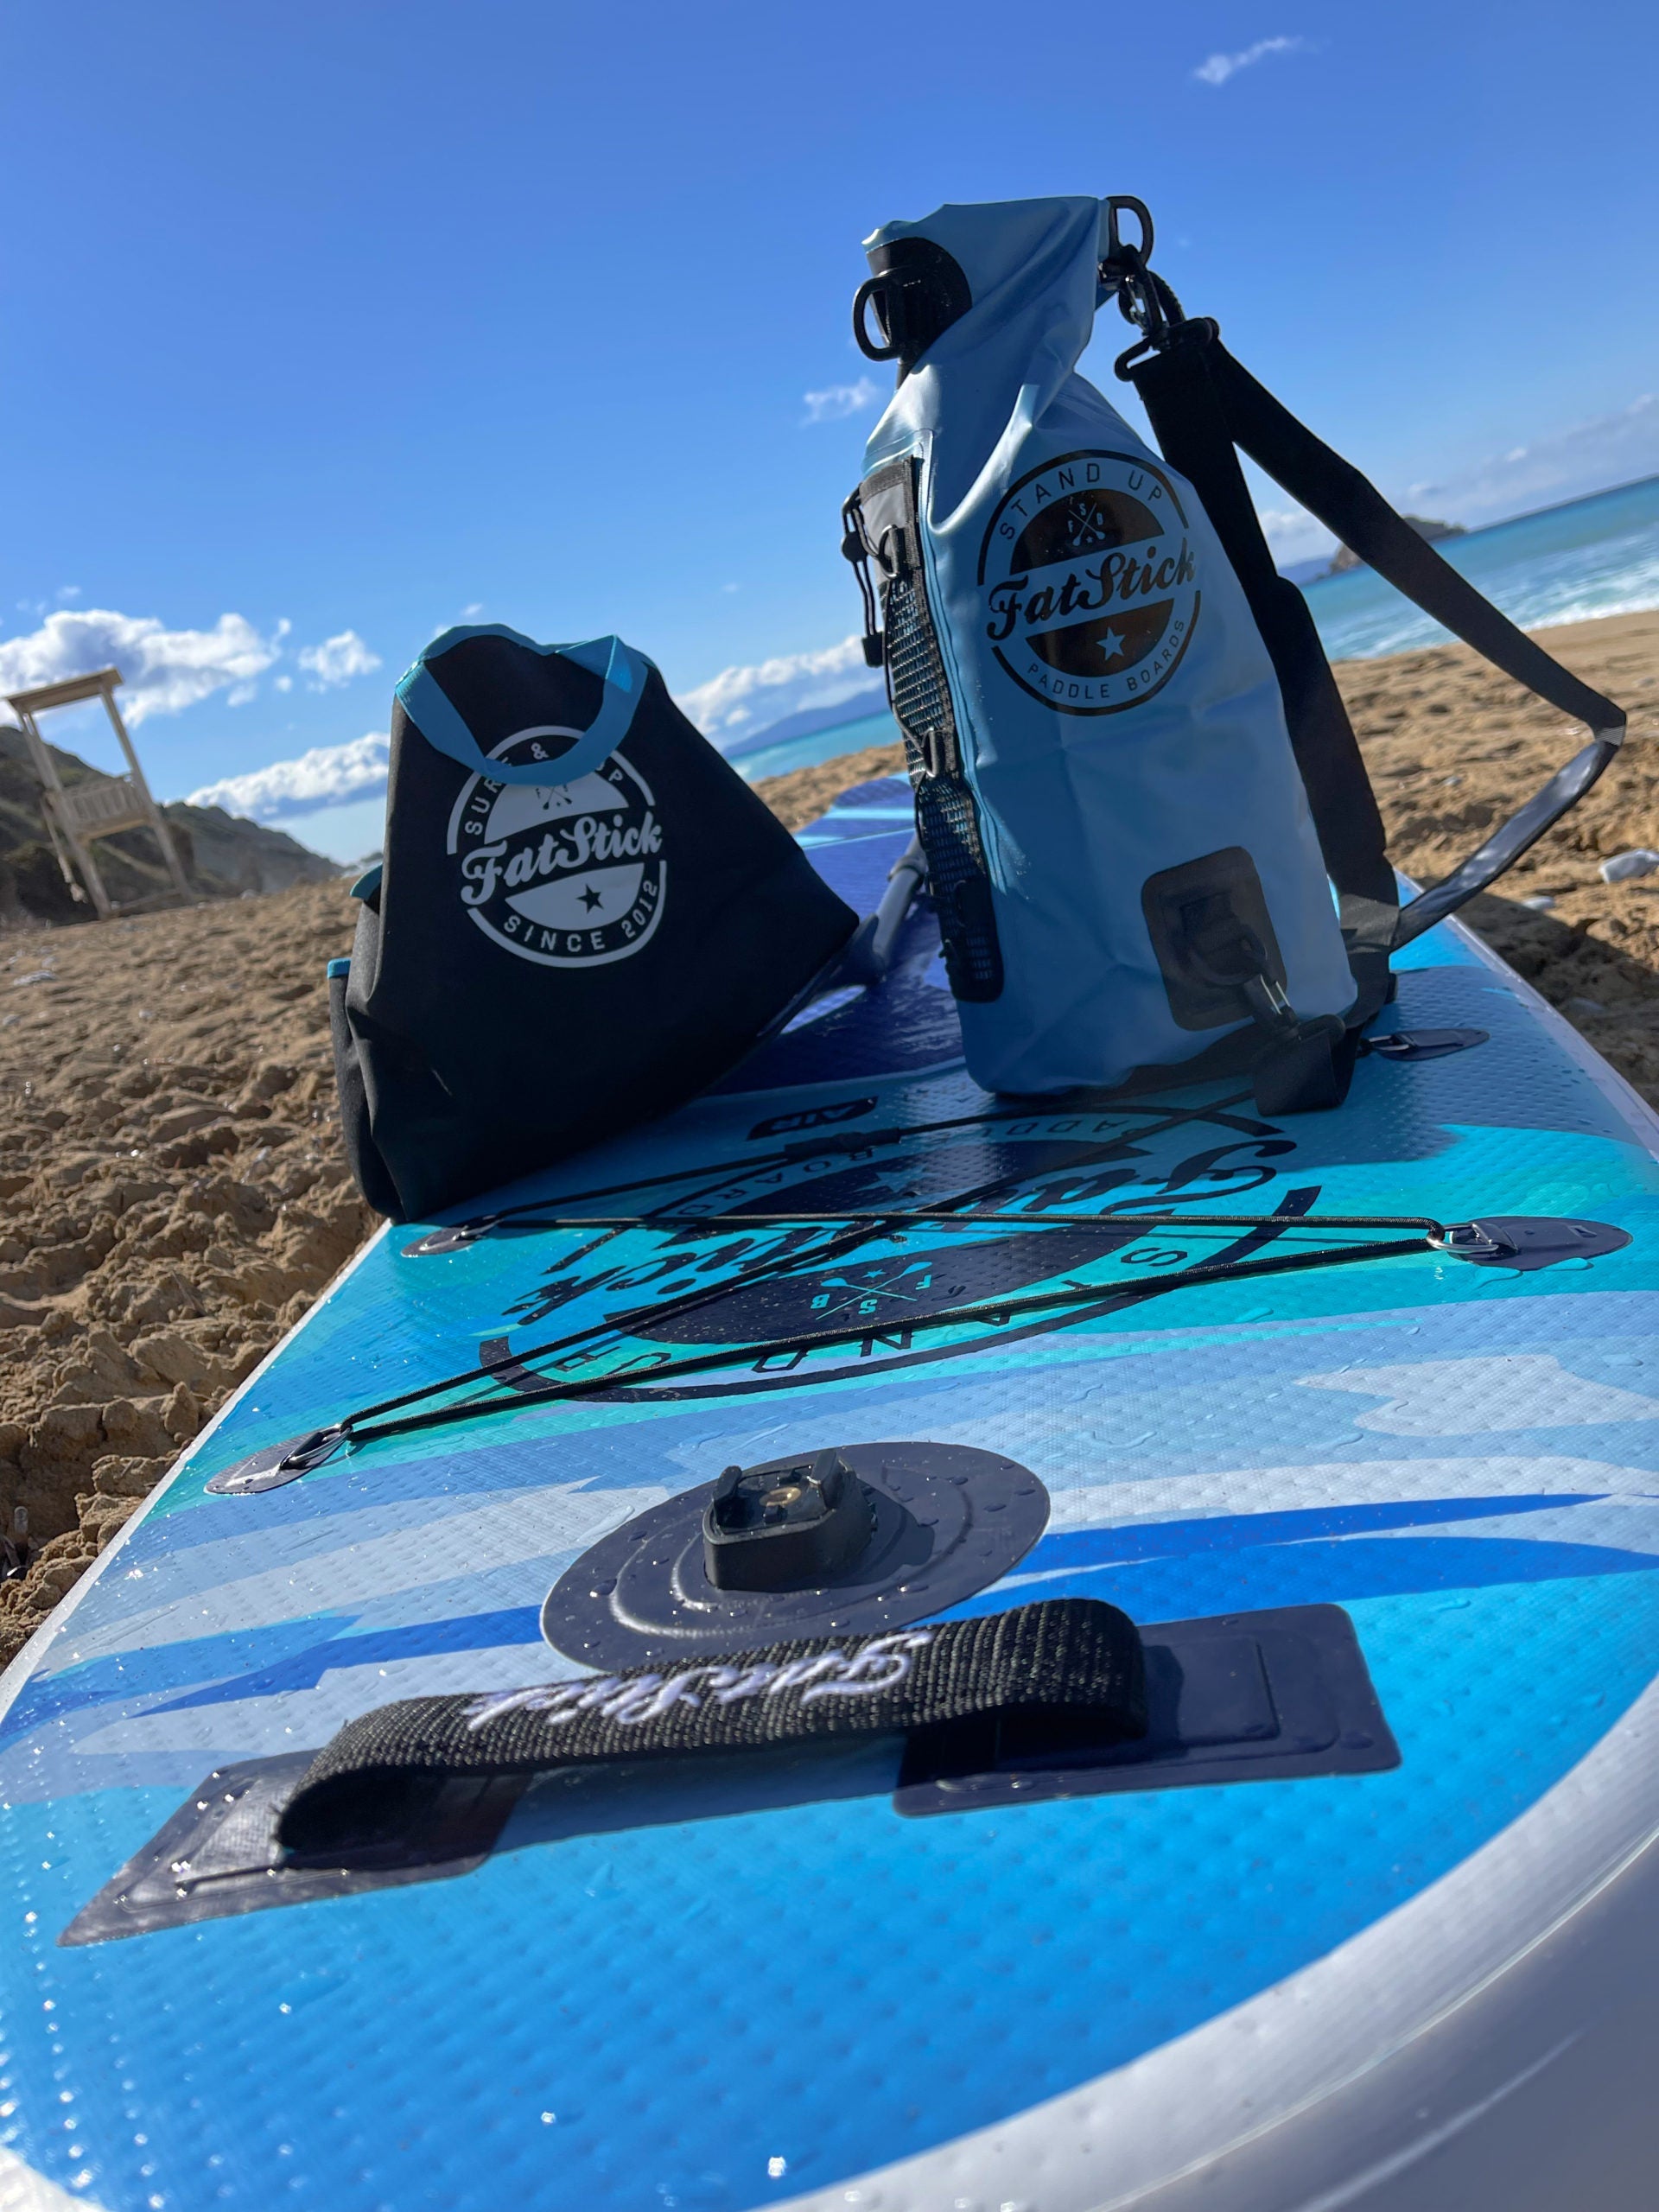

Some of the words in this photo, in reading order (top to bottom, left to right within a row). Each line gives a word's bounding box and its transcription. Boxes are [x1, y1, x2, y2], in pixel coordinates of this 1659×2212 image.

[1000, 462, 1100, 540] STAND
[1128, 470, 1162, 501] UP
[986, 537, 1195, 641] FatStick
[1027, 663, 1109, 700] PADDLE
[1127, 620, 1185, 691] BOARDS
[531, 742, 550, 760] &
[461, 810, 663, 906] FatStick
[504, 914, 606, 952] SINCE
[621, 880, 658, 939] 2012
[464, 1630, 935, 1731] FatStick
